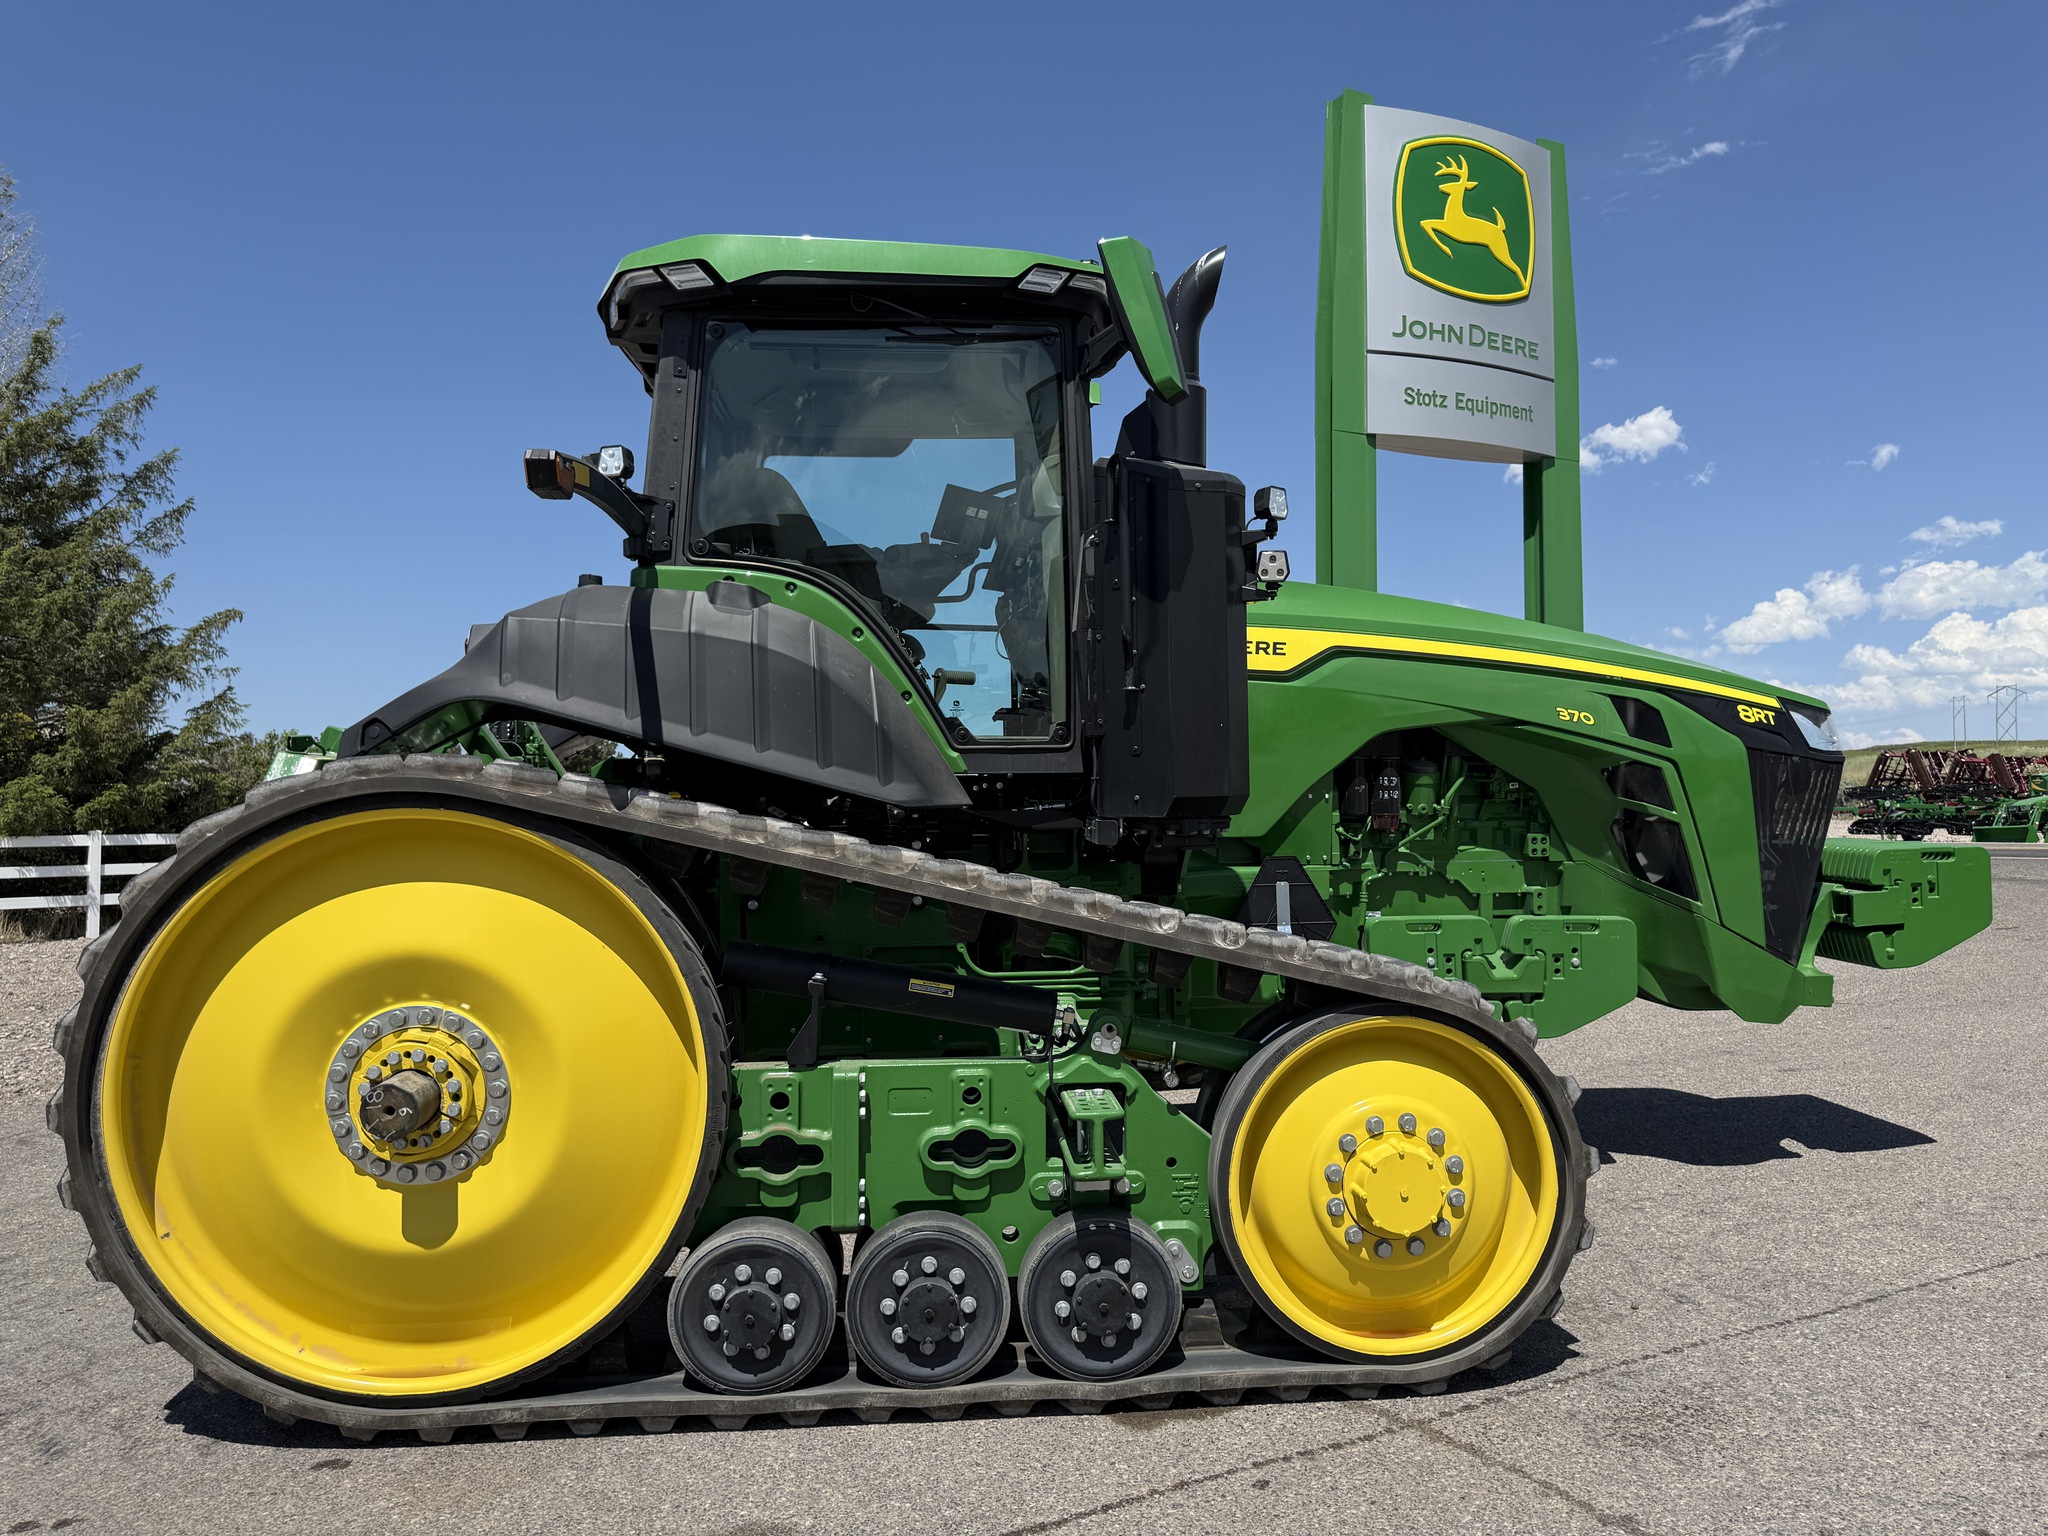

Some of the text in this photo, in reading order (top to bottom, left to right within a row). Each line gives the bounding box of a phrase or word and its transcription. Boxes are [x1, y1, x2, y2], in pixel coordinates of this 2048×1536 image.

[1392, 315, 1539, 360] JOHN DEERE
[1404, 386, 1534, 422] Stotz Equipment
[1555, 706, 1595, 725] 370
[1737, 704, 1775, 725] 8RT
